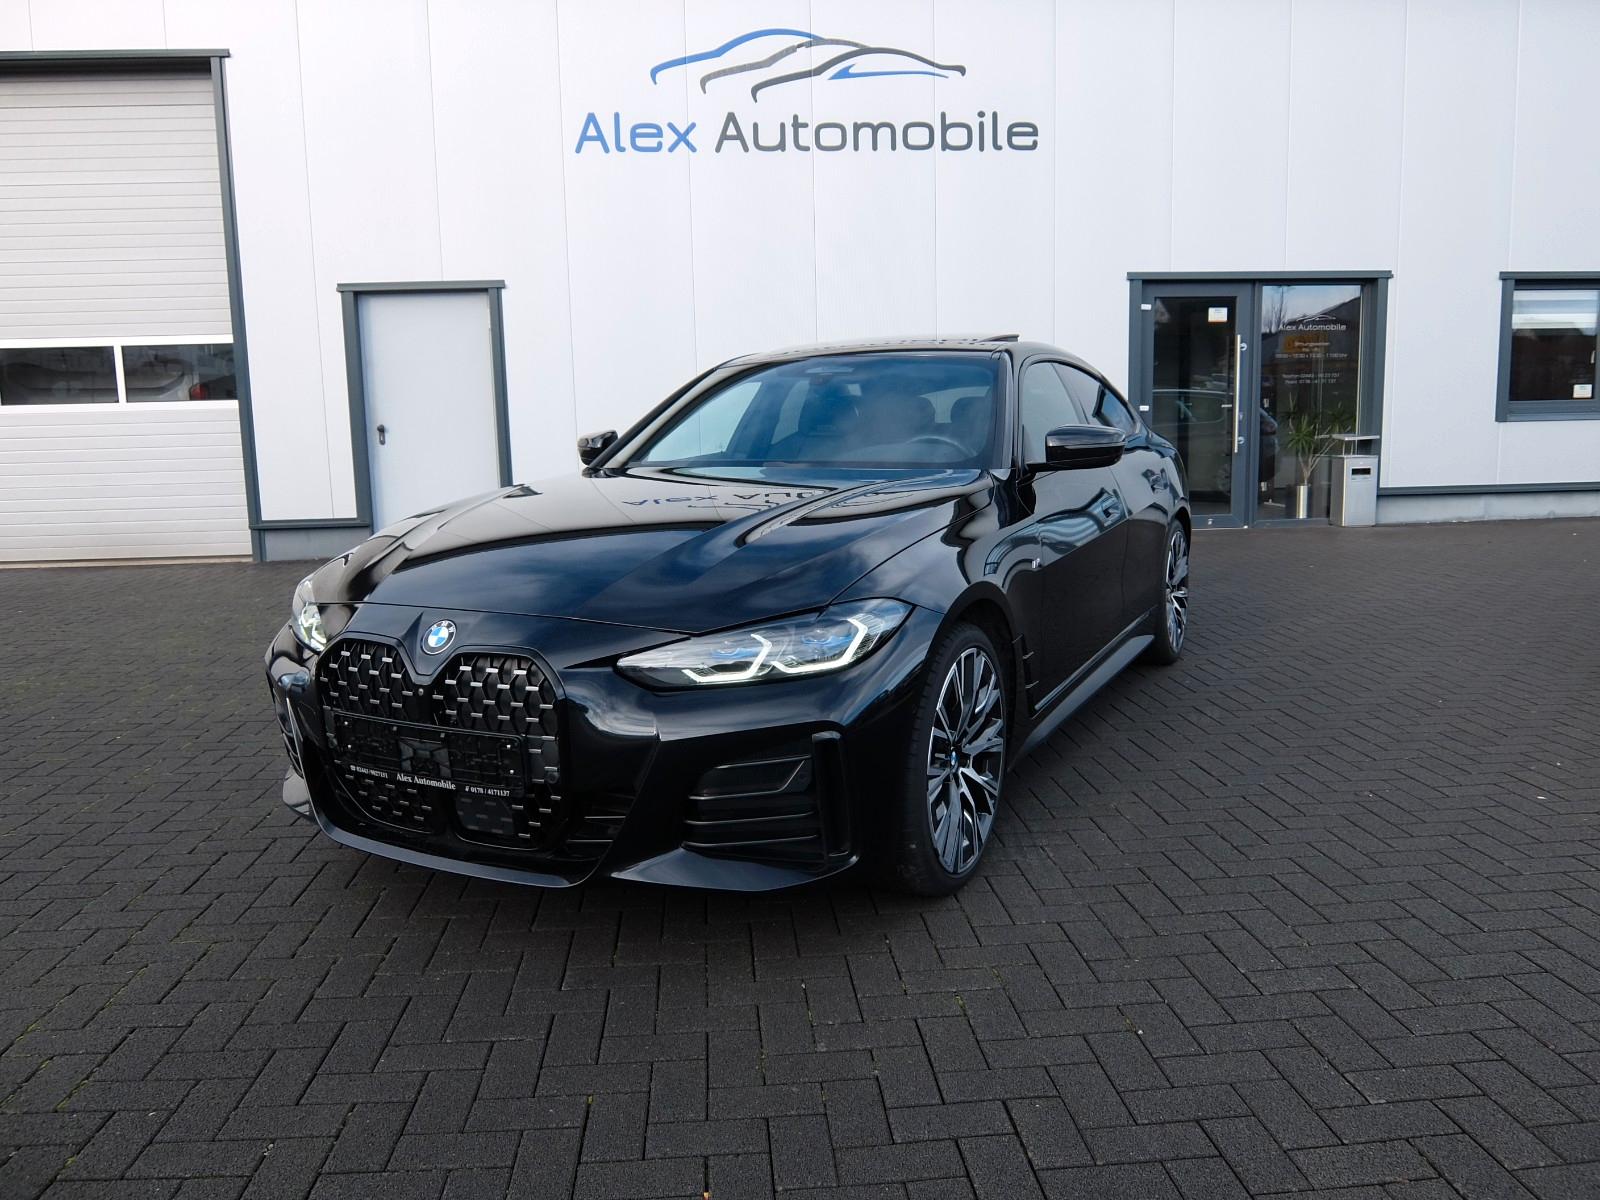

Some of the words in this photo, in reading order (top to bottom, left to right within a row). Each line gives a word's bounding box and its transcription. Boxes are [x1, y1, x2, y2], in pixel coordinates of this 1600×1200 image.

[575, 111, 697, 154] Alex
[714, 111, 1039, 153] Automobile
[1298, 323, 1347, 331] Automobile
[397, 772, 413, 784] Alex
[414, 775, 456, 790] Automobile
